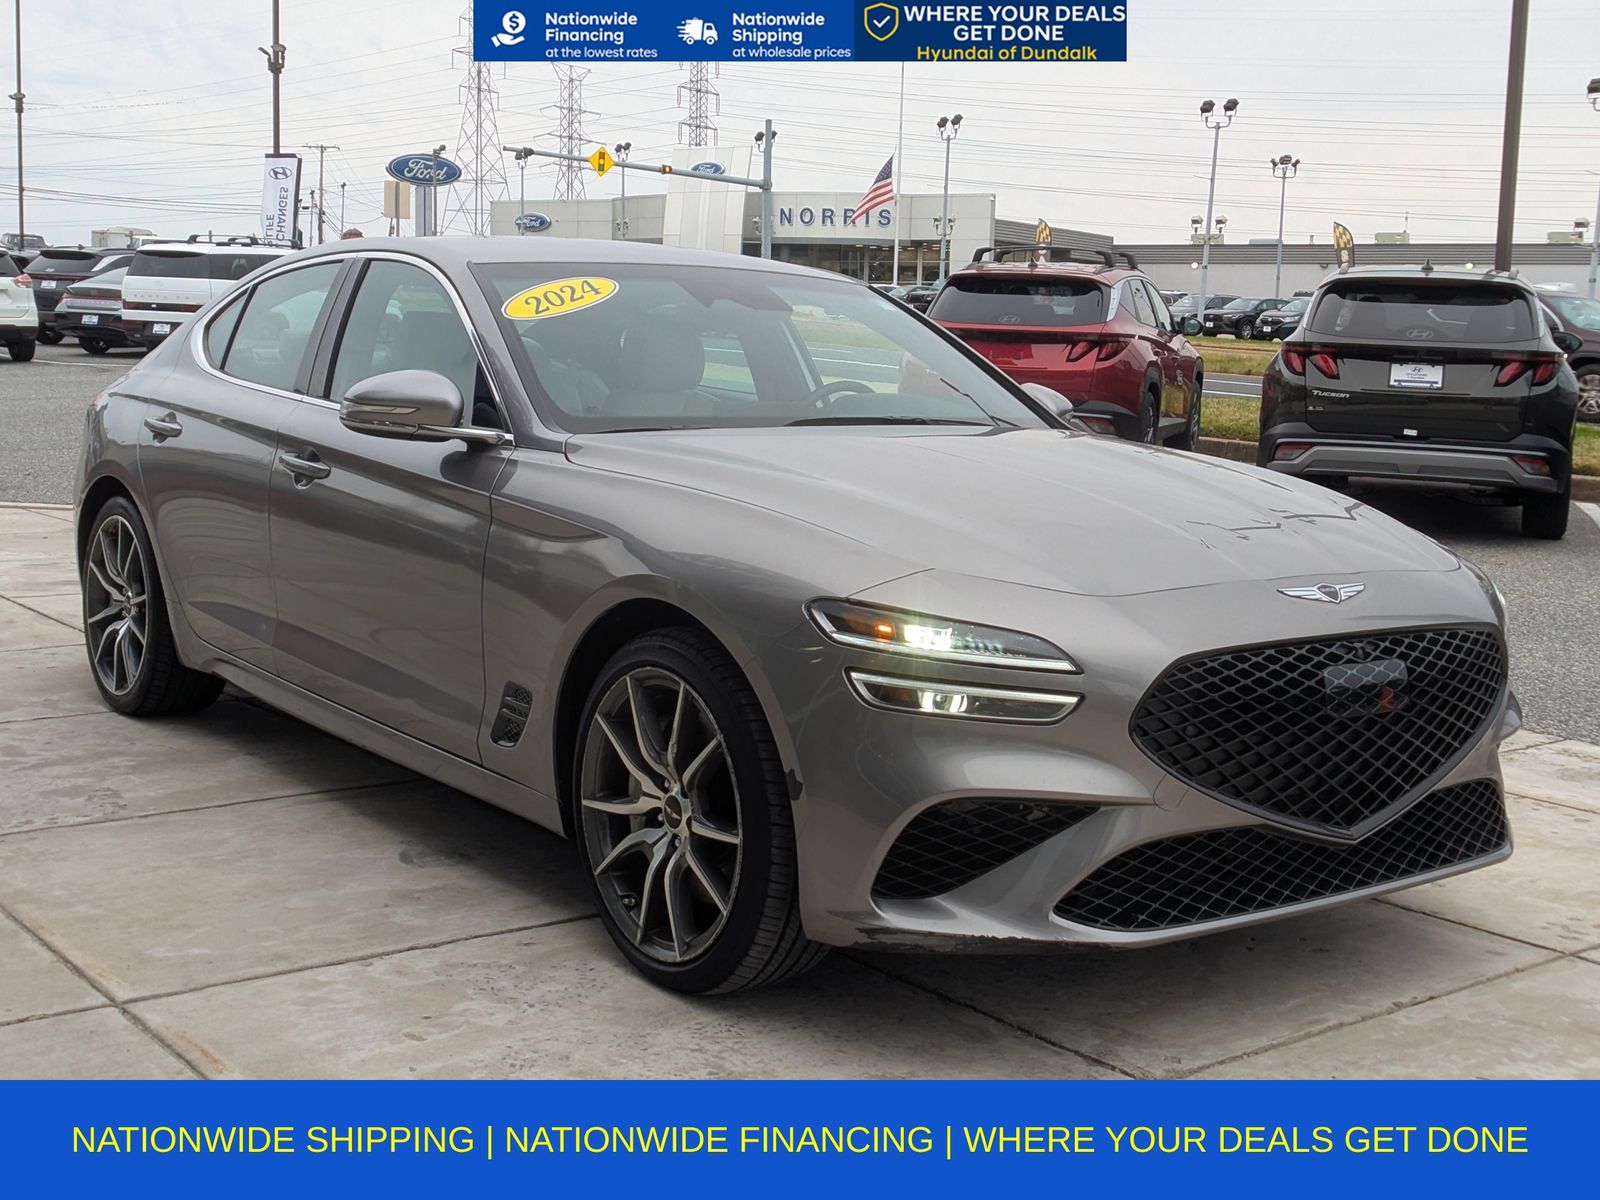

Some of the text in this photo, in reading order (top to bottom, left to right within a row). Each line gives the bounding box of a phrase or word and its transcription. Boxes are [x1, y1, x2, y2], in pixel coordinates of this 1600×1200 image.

[403, 158, 448, 180] Ford
[780, 207, 892, 227] NORRIS
[524, 279, 602, 315] 2024
